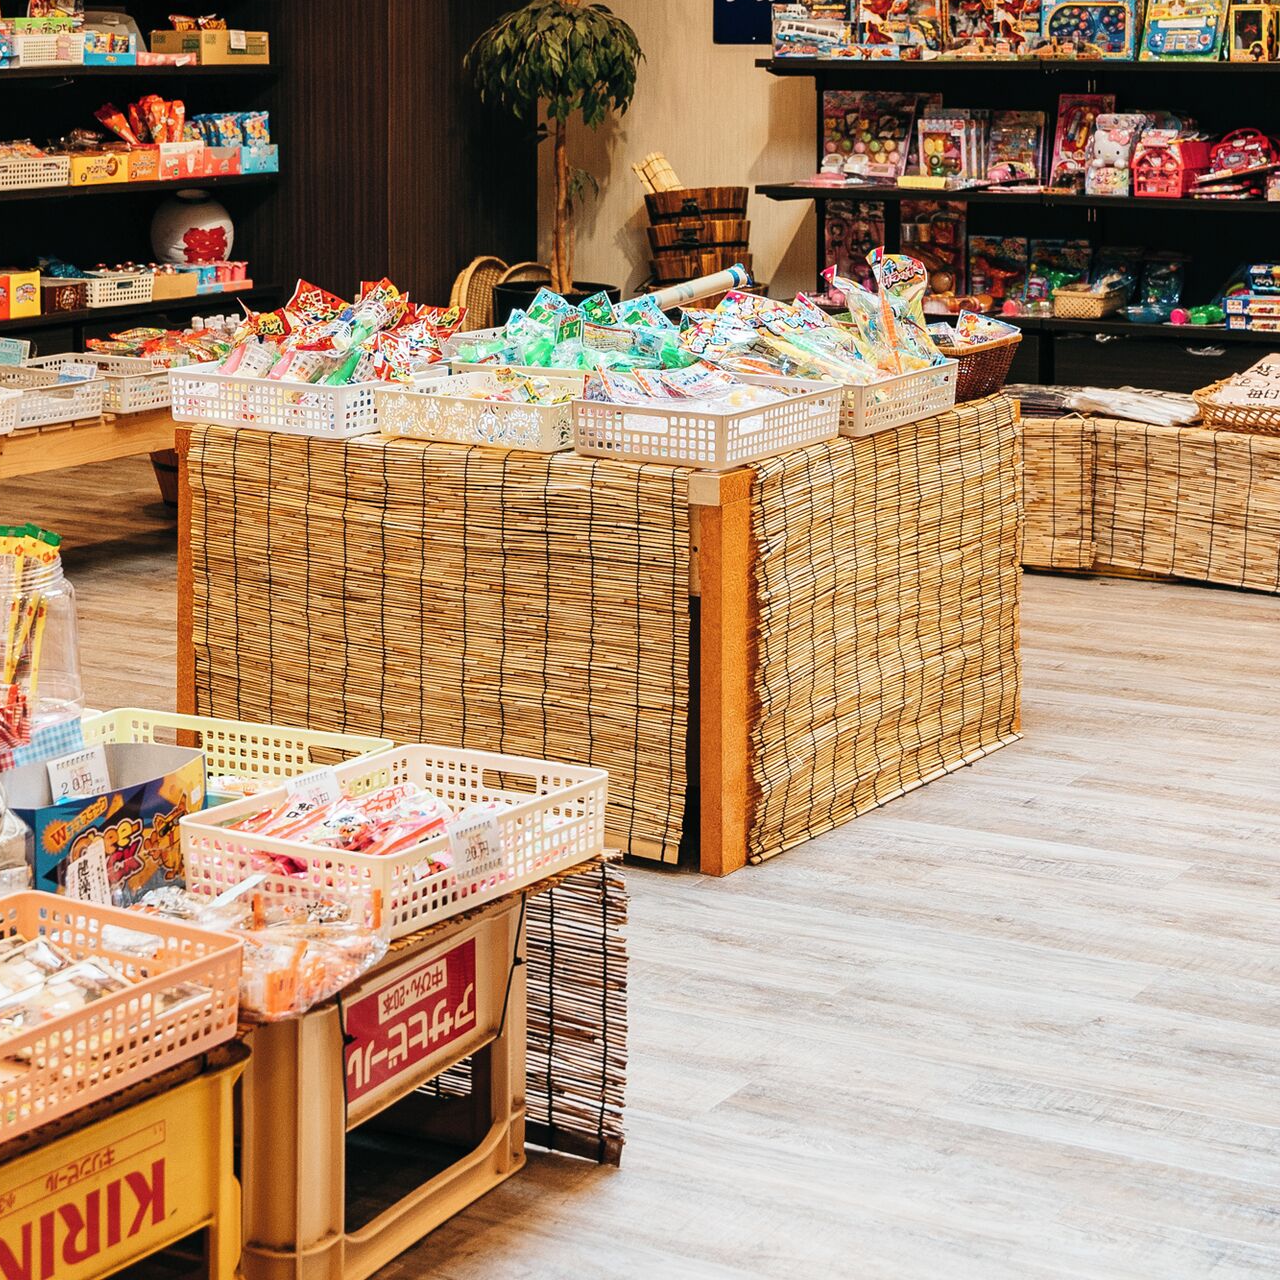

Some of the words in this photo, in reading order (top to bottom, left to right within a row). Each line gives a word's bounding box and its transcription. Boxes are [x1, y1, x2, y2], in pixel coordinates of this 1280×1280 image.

[345, 981, 475, 1090] アサヒビール
[45, 1147, 116, 1193] キリンビール
